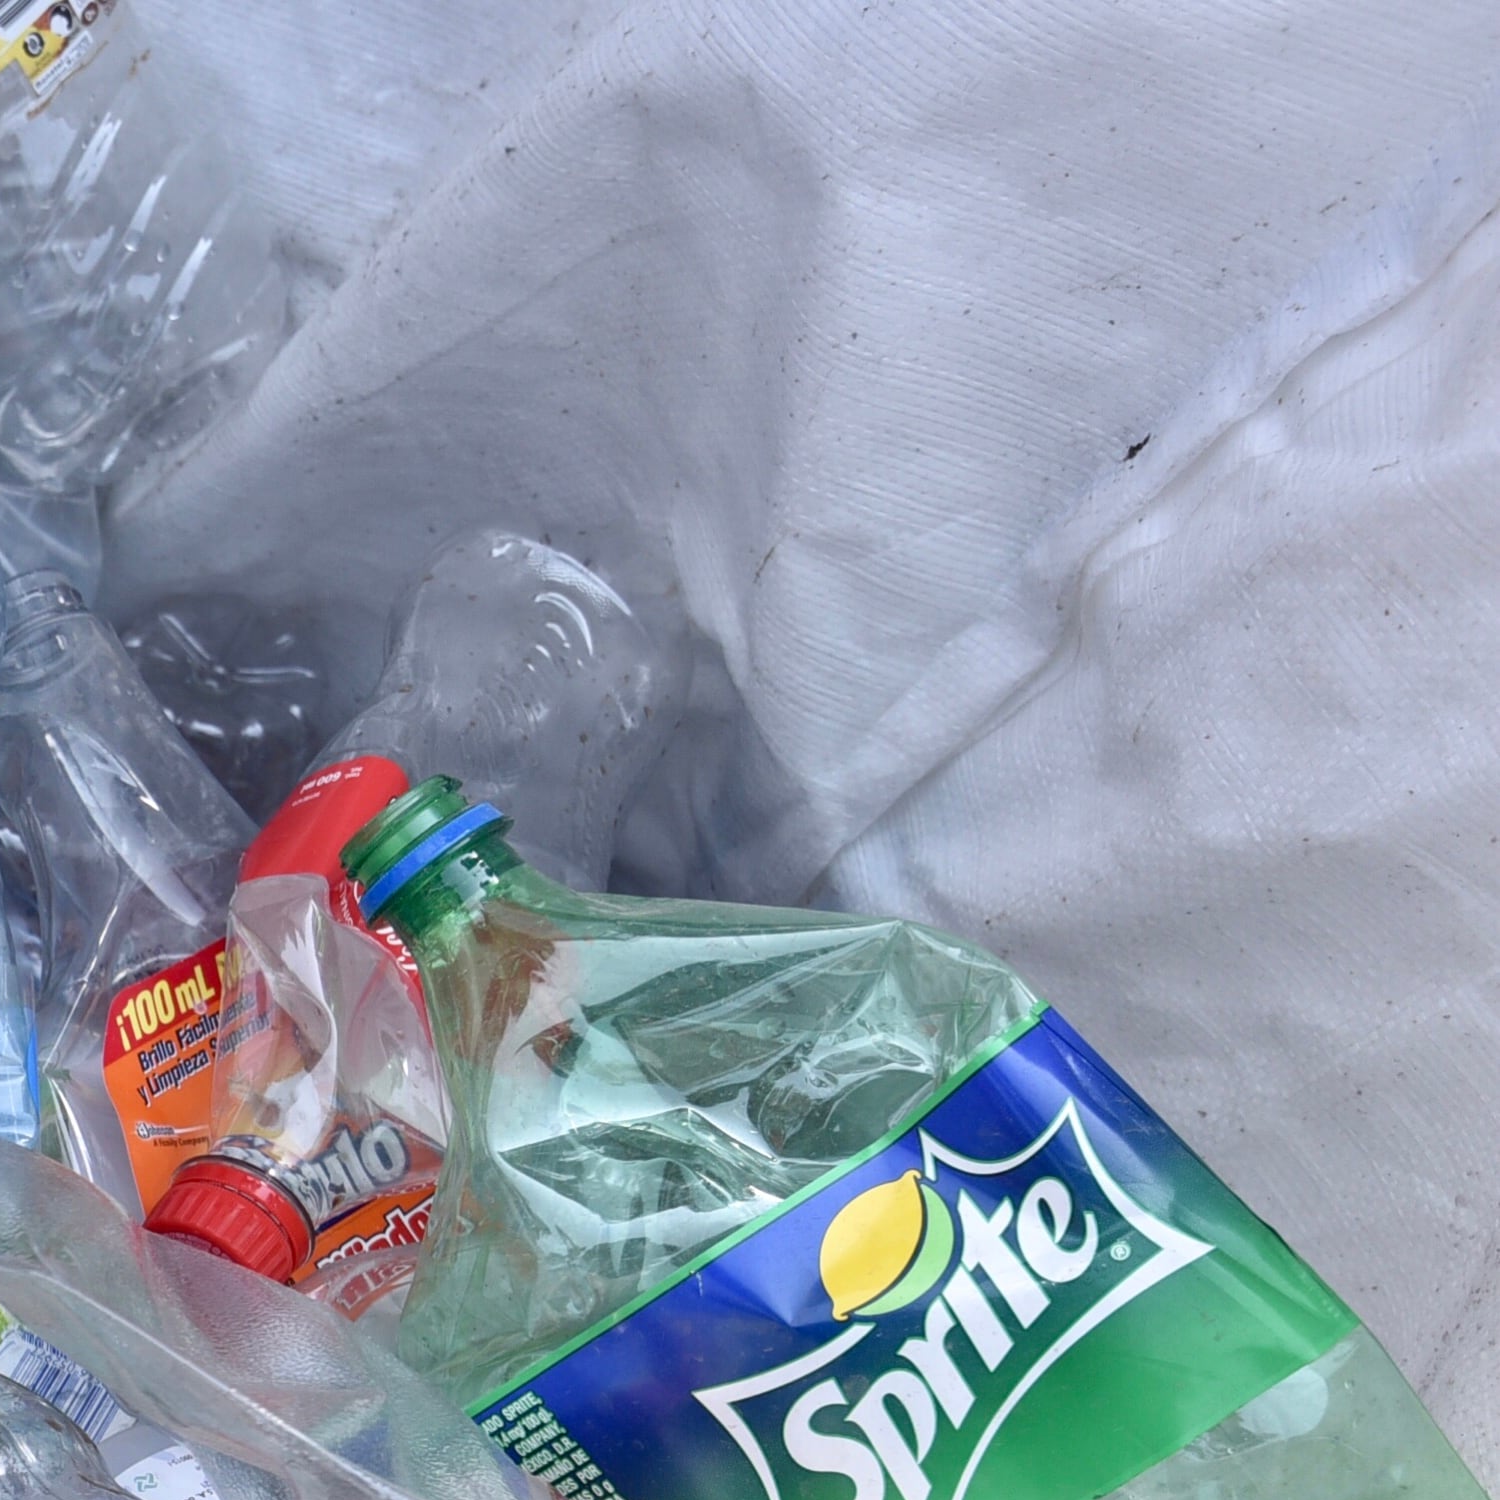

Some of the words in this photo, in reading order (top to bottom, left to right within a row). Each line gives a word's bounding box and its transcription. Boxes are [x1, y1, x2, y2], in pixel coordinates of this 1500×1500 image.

[314, 769, 343, 787] 600
[166, 962, 218, 1014] mL
[134, 1037, 180, 1074] Brillo
[172, 992, 262, 1052] Fácilmente
[205, 1010, 276, 1059] Superior
[143, 1047, 214, 1099] Limpieza
[136, 1084, 153, 1108] y
[499, 1389, 543, 1424] SPRITE,
[570, 1446, 590, 1466] DE
[576, 1461, 602, 1485] POR
